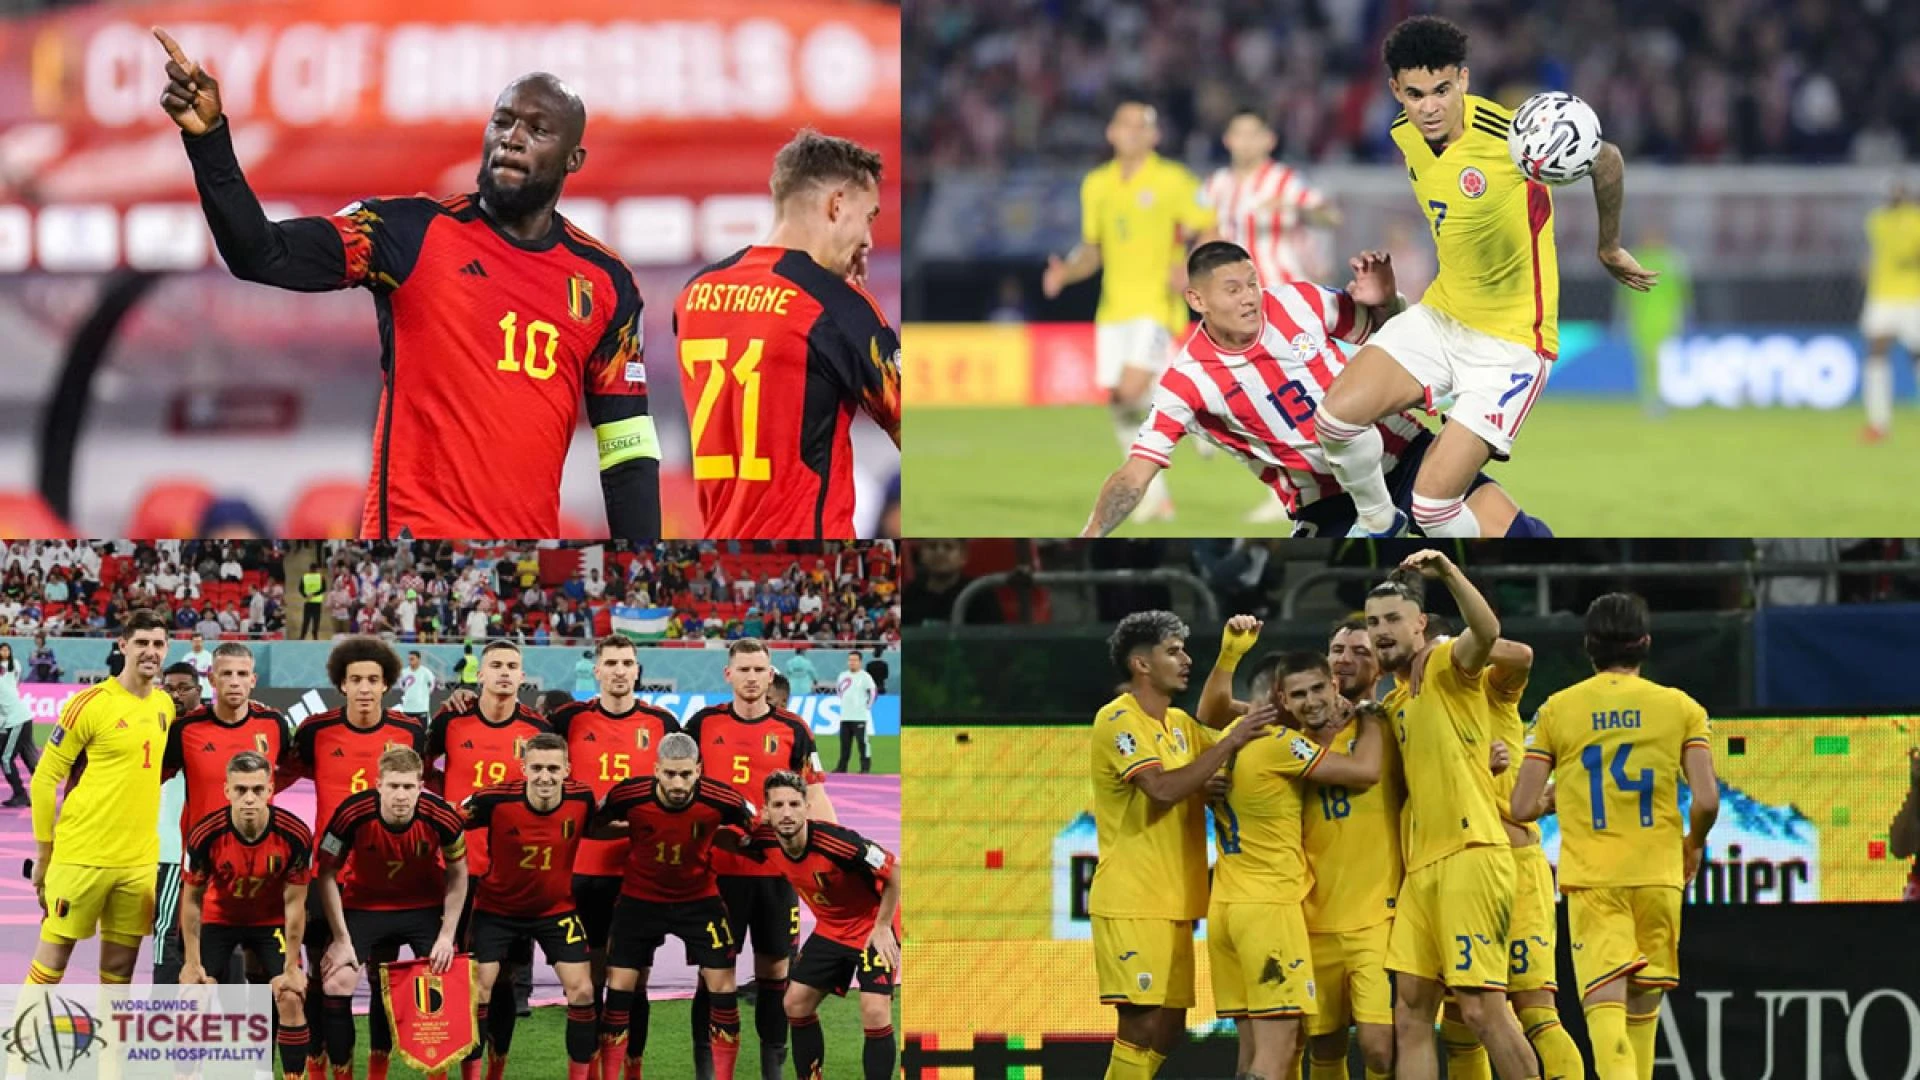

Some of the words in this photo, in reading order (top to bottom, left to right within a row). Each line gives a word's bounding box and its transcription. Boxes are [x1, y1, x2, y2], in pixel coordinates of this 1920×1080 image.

[1428, 200, 1447, 236] 7
[685, 283, 798, 316] CASTAGNE
[497, 311, 559, 380] 10
[1266, 379, 1317, 430] 13
[1499, 373, 1533, 408] 7
[681, 338, 771, 480] 21
[1591, 710, 1641, 730] HAGI
[142, 740, 152, 768] 1
[599, 752, 632, 781] 15
[351, 768, 369, 794] 6
[472, 760, 507, 787] 19
[733, 755, 750, 784] 5
[1581, 743, 1655, 830] 14
[1319, 785, 1350, 821] 18
[519, 845, 553, 870] 21
[655, 842, 682, 865] 11
[387, 861, 404, 879] 7
[233, 877, 264, 898] 17
[706, 918, 734, 949] 11
[1455, 935, 1473, 971] 3
